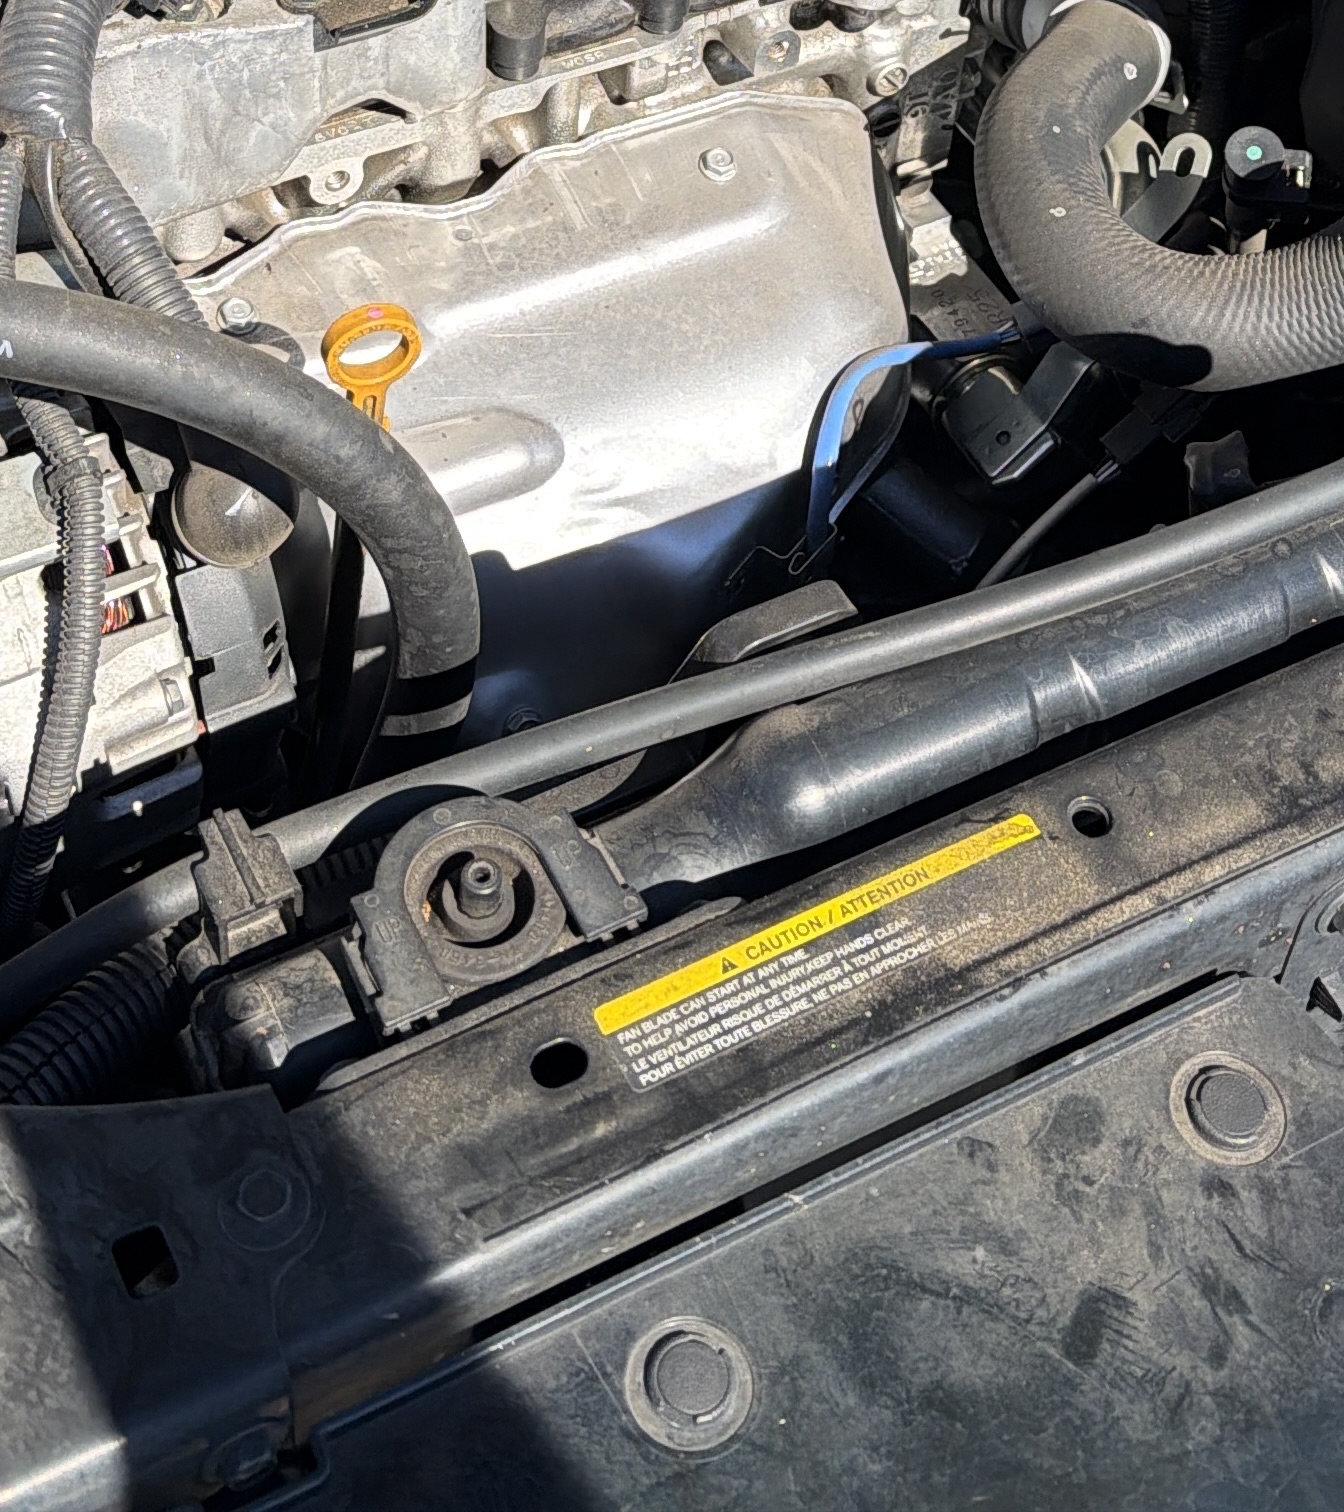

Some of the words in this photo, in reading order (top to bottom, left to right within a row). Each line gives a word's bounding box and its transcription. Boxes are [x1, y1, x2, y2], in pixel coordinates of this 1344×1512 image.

[375, 916, 402, 944] UP
[744, 915, 824, 962] CAUTION
[824, 909, 835, 924] /
[837, 865, 930, 918] ATTENTION
[616, 1025, 642, 1044] FAN
[641, 1007, 680, 1033] BLADE
[678, 995, 706, 1015] CAN
[705, 978, 741, 1002] START
[741, 971, 757, 986] AT
[755, 960, 780, 979] ANY
[623, 1041, 643, 1058] TO
[641, 1026, 674, 1049] HELP
[673, 1010, 710, 1035] AVOID
[708, 981, 770, 1018] PERSONAL
[834, 932, 875, 959] HANDS
[631, 1057, 649, 1073] LE
[647, 1022, 722, 1065] VENTILATEUR
[720, 1001, 766, 1030] RISQUE
[764, 993, 782, 1010] DE
[780, 964, 843, 1002] DÉMARRER
[840, 957, 854, 973] À
[851, 947, 881, 968] TOUT
[638, 1061, 676, 1086] POUR
[672, 1040, 715, 1069] ÉVITER
[713, 1025, 752, 1051] TOUTE
[750, 995, 814, 1033] BLESSURE,
[812, 987, 831, 1003] NE
[829, 977, 852, 995] PAS
[851, 969, 869, 984] EN
[868, 937, 937, 977] APPROCHER
[934, 927, 957, 945] LES
